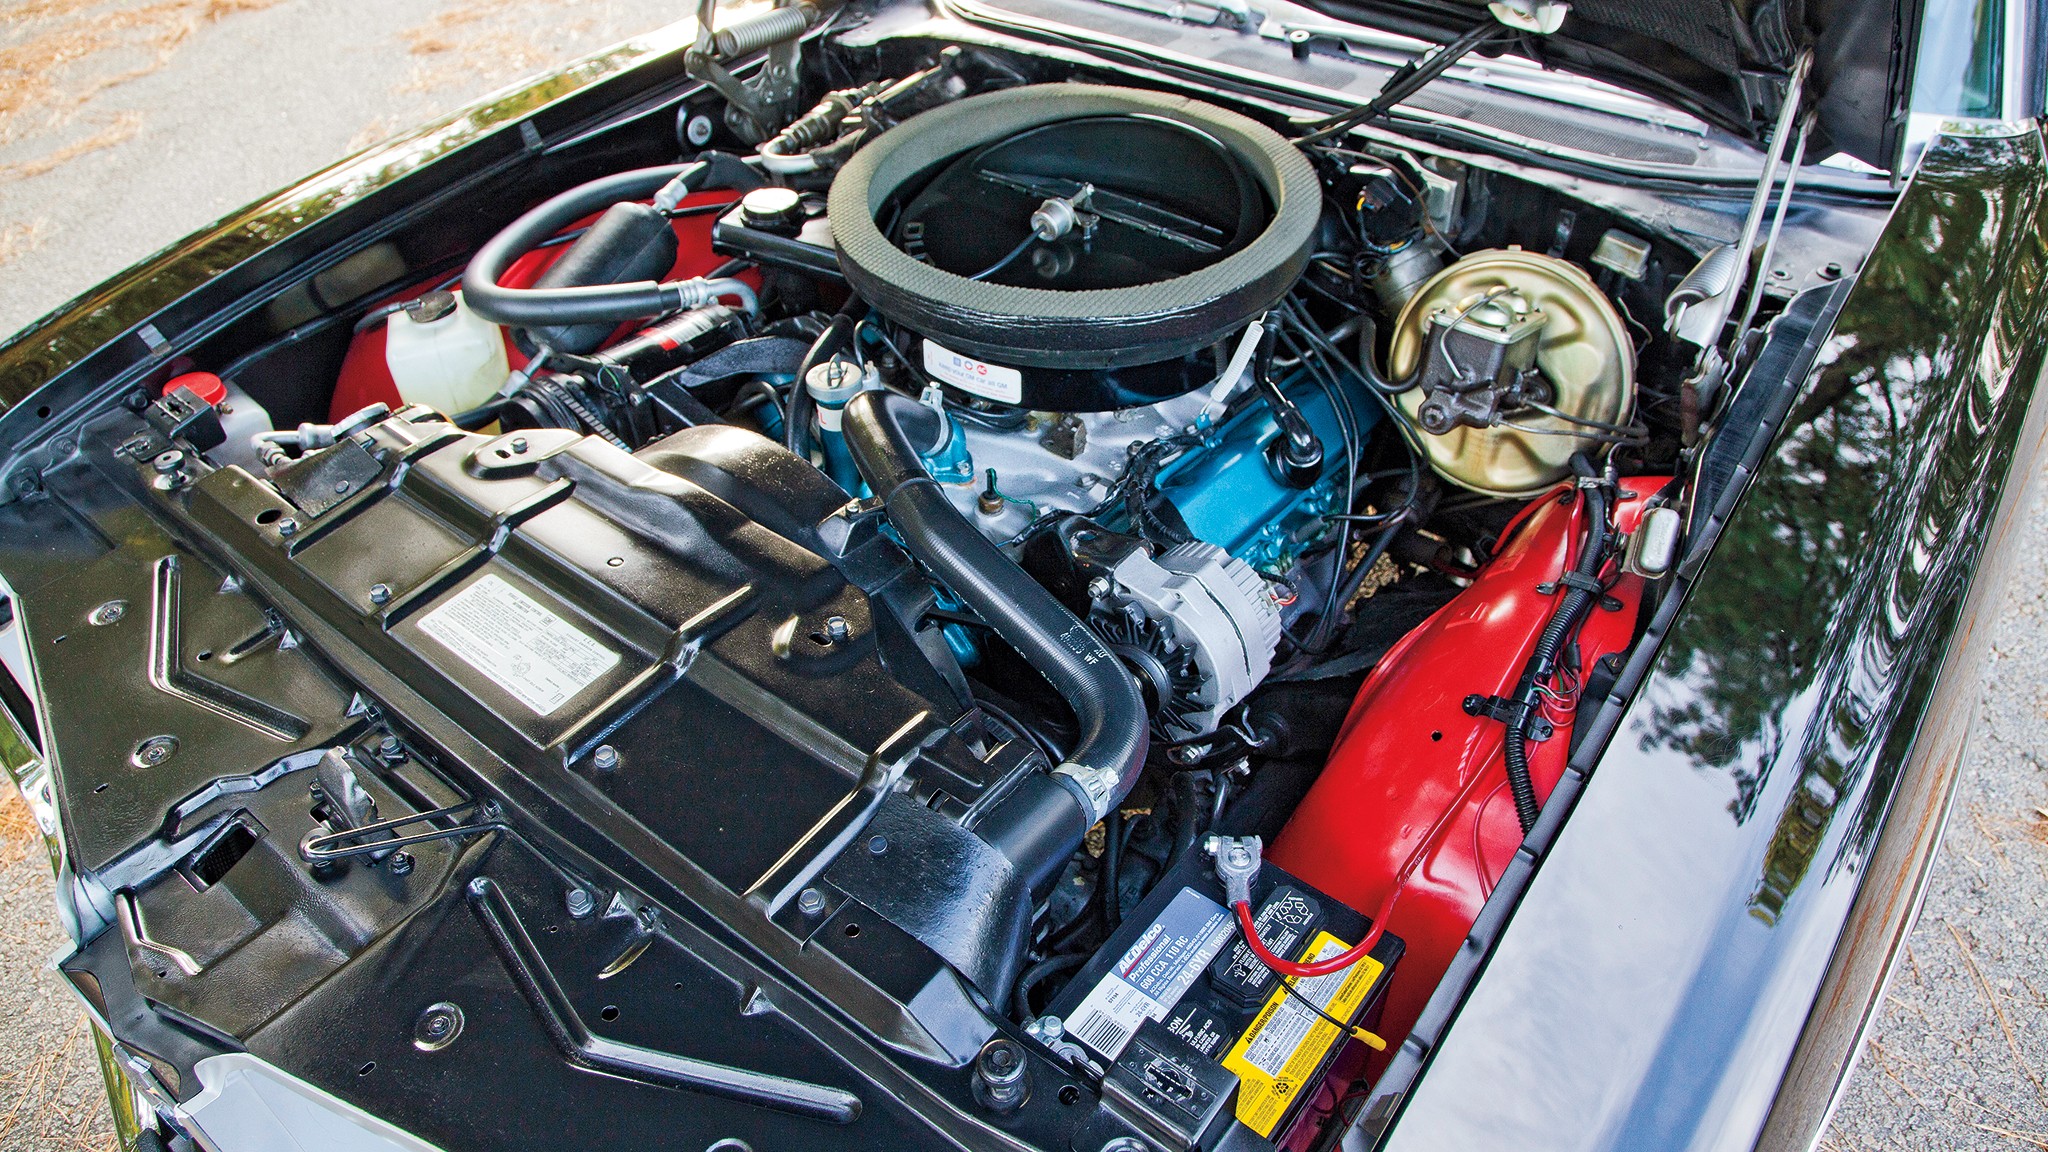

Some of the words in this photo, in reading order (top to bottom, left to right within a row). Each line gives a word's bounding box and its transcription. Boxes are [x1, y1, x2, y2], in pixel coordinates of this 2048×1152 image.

[1118, 923, 1165, 974] ACDelco
[1129, 935, 1172, 982] Professional
[1140, 974, 1155, 990] 600
[1151, 960, 1167, 977] CCA
[1165, 945, 1181, 961] 110
[1177, 935, 1188, 950] RC
[1178, 948, 1213, 986] 24-6YR
